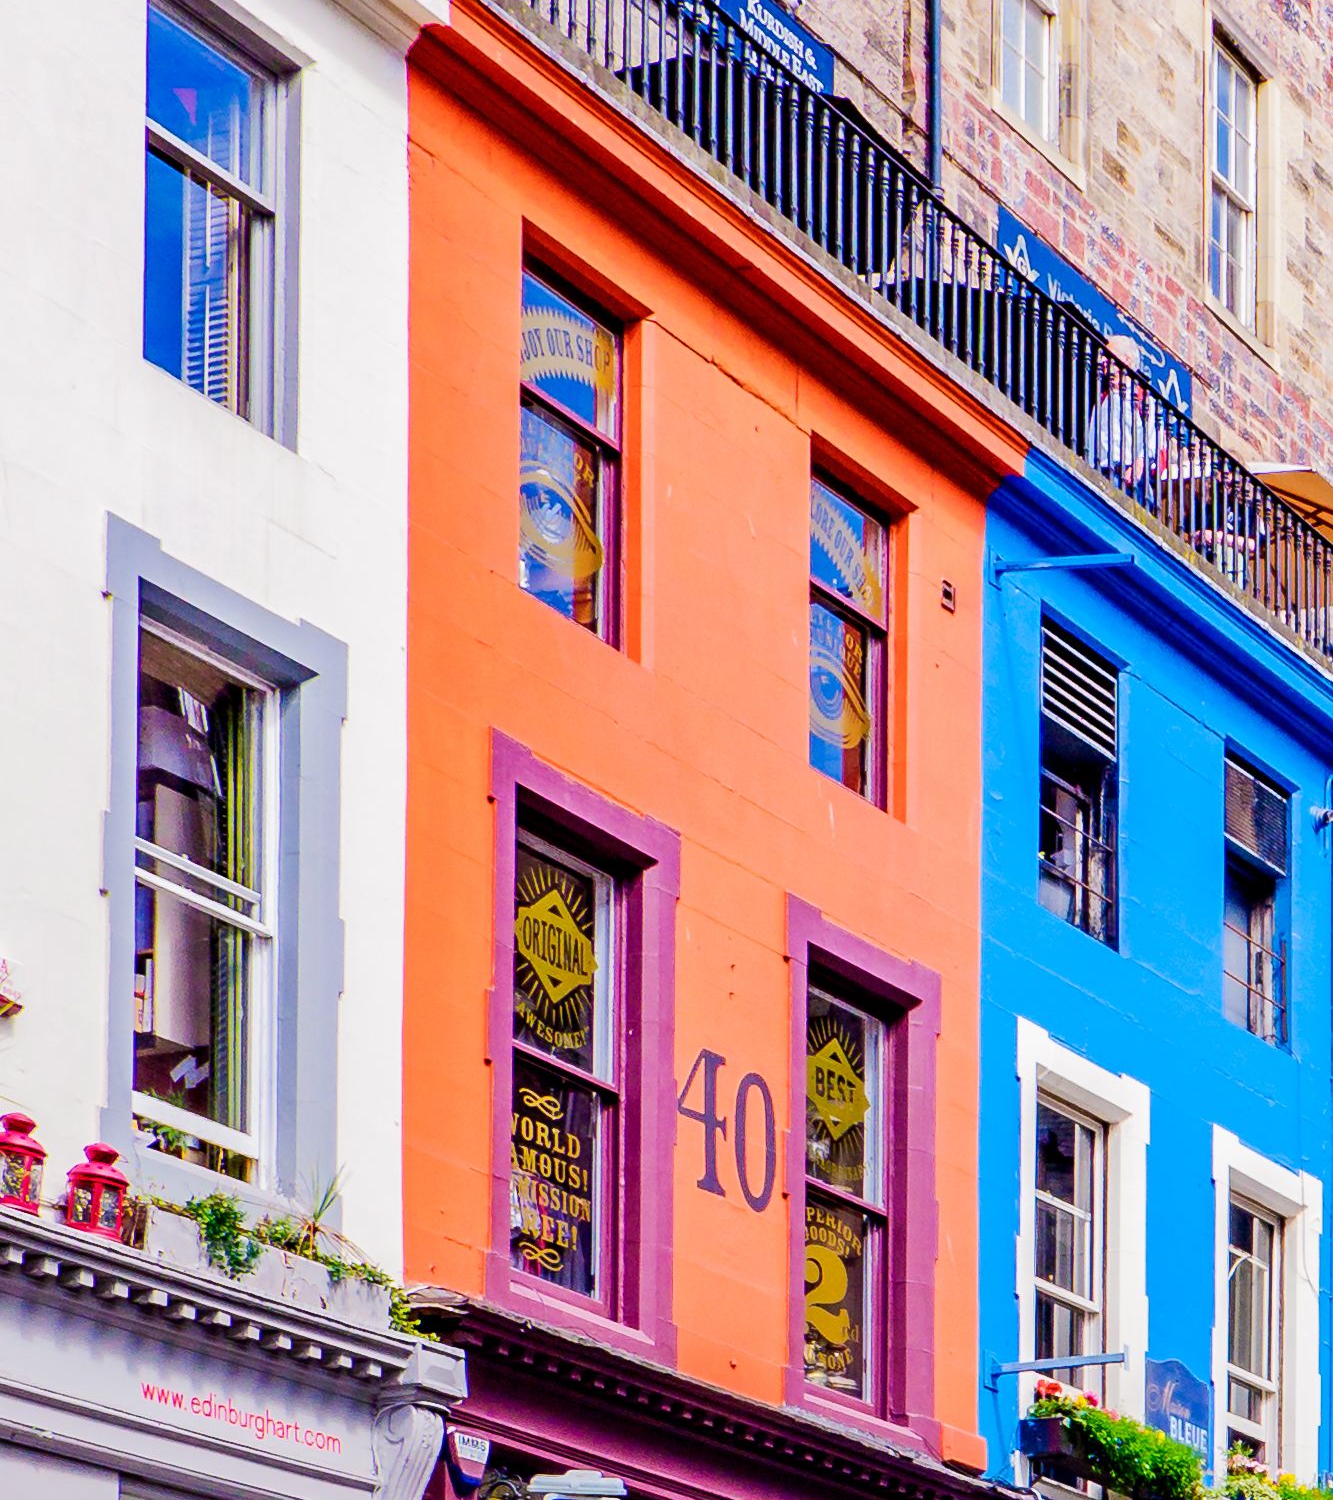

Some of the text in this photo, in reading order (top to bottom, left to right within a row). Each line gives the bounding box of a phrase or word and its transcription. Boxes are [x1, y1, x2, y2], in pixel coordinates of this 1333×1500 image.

[546, 327, 573, 361] OUR
[576, 334, 612, 373] SHOP
[522, 914, 588, 977] ORIGINAL
[815, 1065, 856, 1104] BEST
[678, 1047, 777, 1213] 40
[1169, 1415, 1208, 1454] BLEUE
